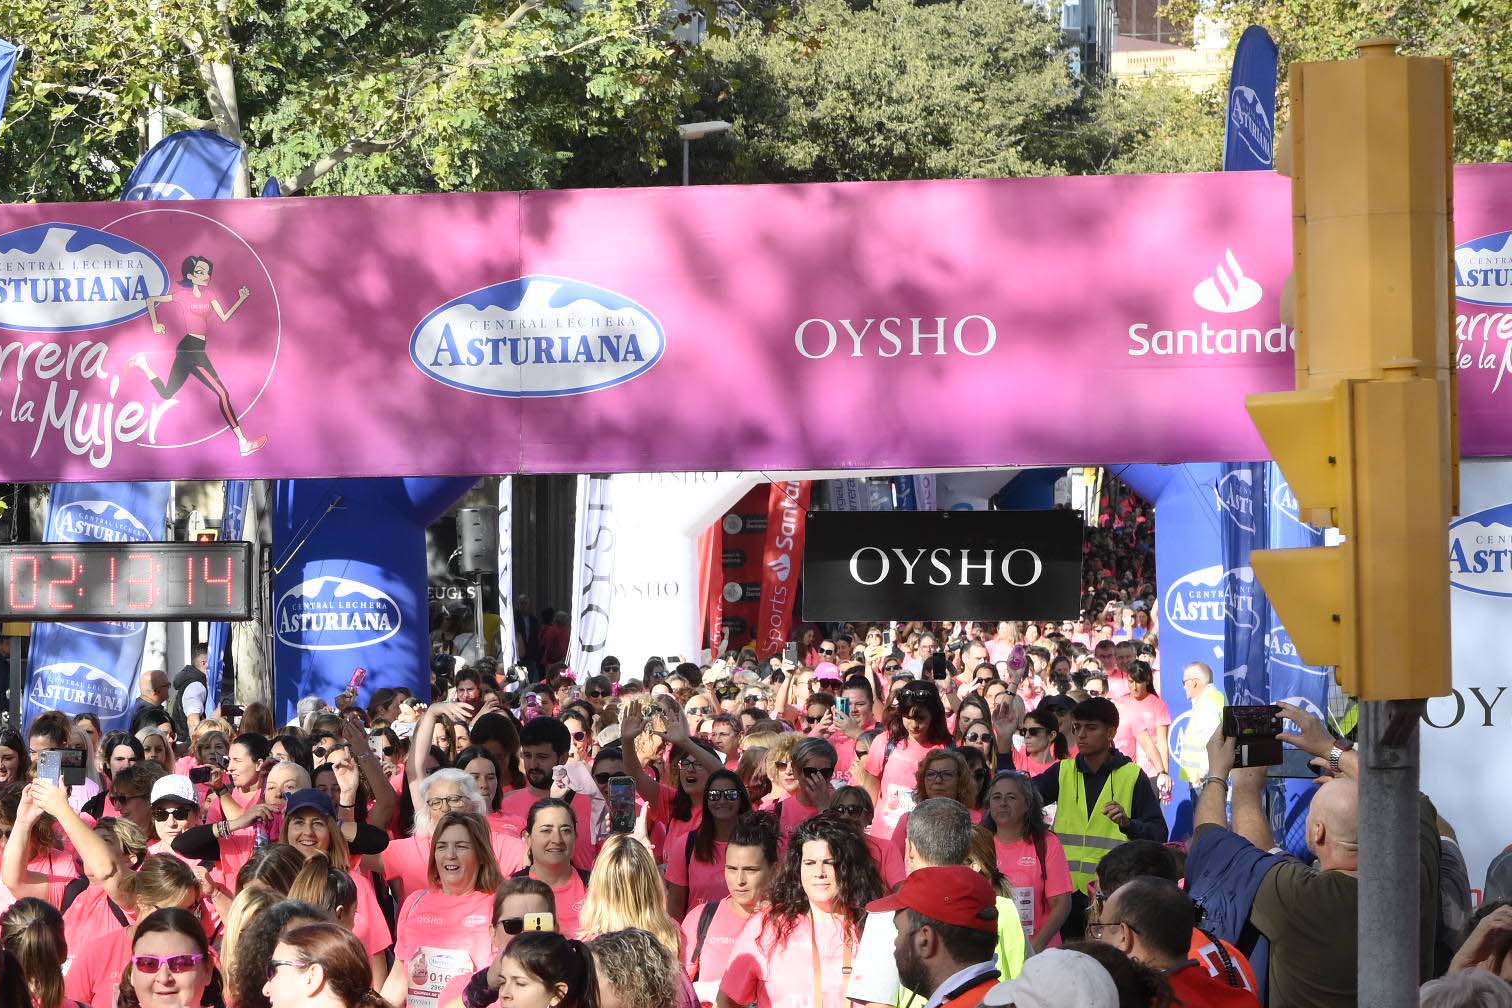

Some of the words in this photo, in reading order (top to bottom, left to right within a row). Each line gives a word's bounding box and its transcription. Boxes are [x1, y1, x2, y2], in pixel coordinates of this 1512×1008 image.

[72, 260, 144, 270] LECHERA
[469, 319, 548, 331] CENTRAL
[556, 316, 637, 328] LECHERA
[794, 314, 997, 359] OYSHO
[430, 322, 645, 366] ASTURIANA
[1478, 343, 1496, 369] la
[10, 384, 35, 423] la
[31, 375, 180, 469] Mujer
[10, 554, 233, 609] 02:13:14
[849, 547, 1044, 587] OYSHO
[279, 606, 392, 633] ASTURIANA
[339, 601, 387, 609] LECHERA
[762, 585, 788, 654] Sports
[30, 677, 123, 712] ASTURIANA
